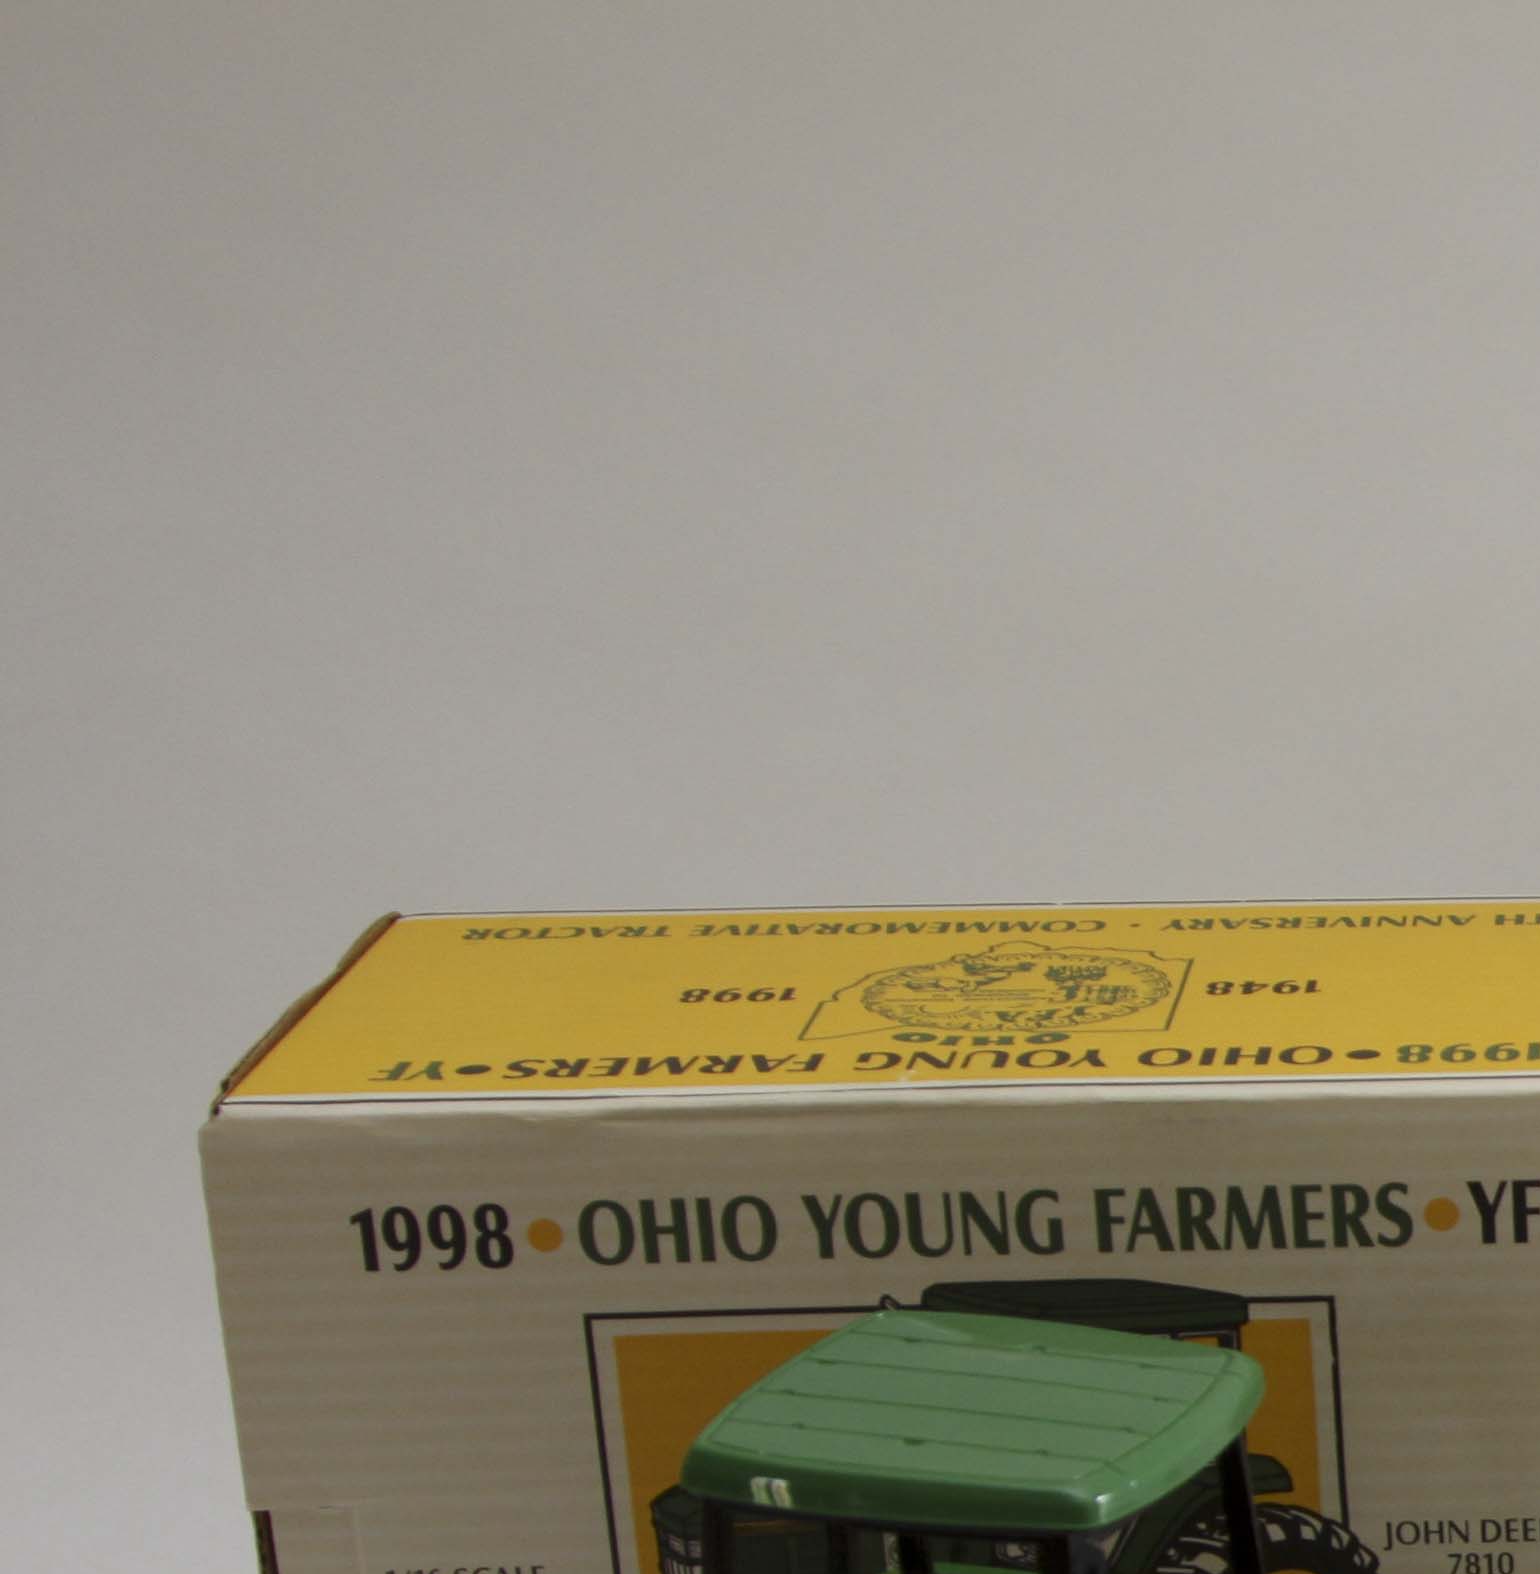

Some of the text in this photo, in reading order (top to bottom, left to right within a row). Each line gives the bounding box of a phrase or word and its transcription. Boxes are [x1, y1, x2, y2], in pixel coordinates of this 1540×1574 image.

[693, 920, 1107, 937] COMMEMORATIVE
[1163, 914, 1475, 930] ANNIVERSARY
[461, 926, 672, 941] TRACTOR
[678, 987, 798, 1004] 1998
[1205, 980, 1322, 996] 1948
[892, 1032, 1070, 1046] OHIO
[853, 1047, 1106, 1072] YOUNG
[1137, 1044, 1334, 1068] OHIO
[373, 1060, 444, 1082] YF
[502, 1053, 822, 1079] FARMERS
[349, 1203, 515, 1273] 1998
[577, 1195, 778, 1266] OHIO
[799, 1187, 1064, 1258] YOUNG
[1093, 1181, 1415, 1255] FARMERS
[1383, 1518, 1471, 1550] JOHN
